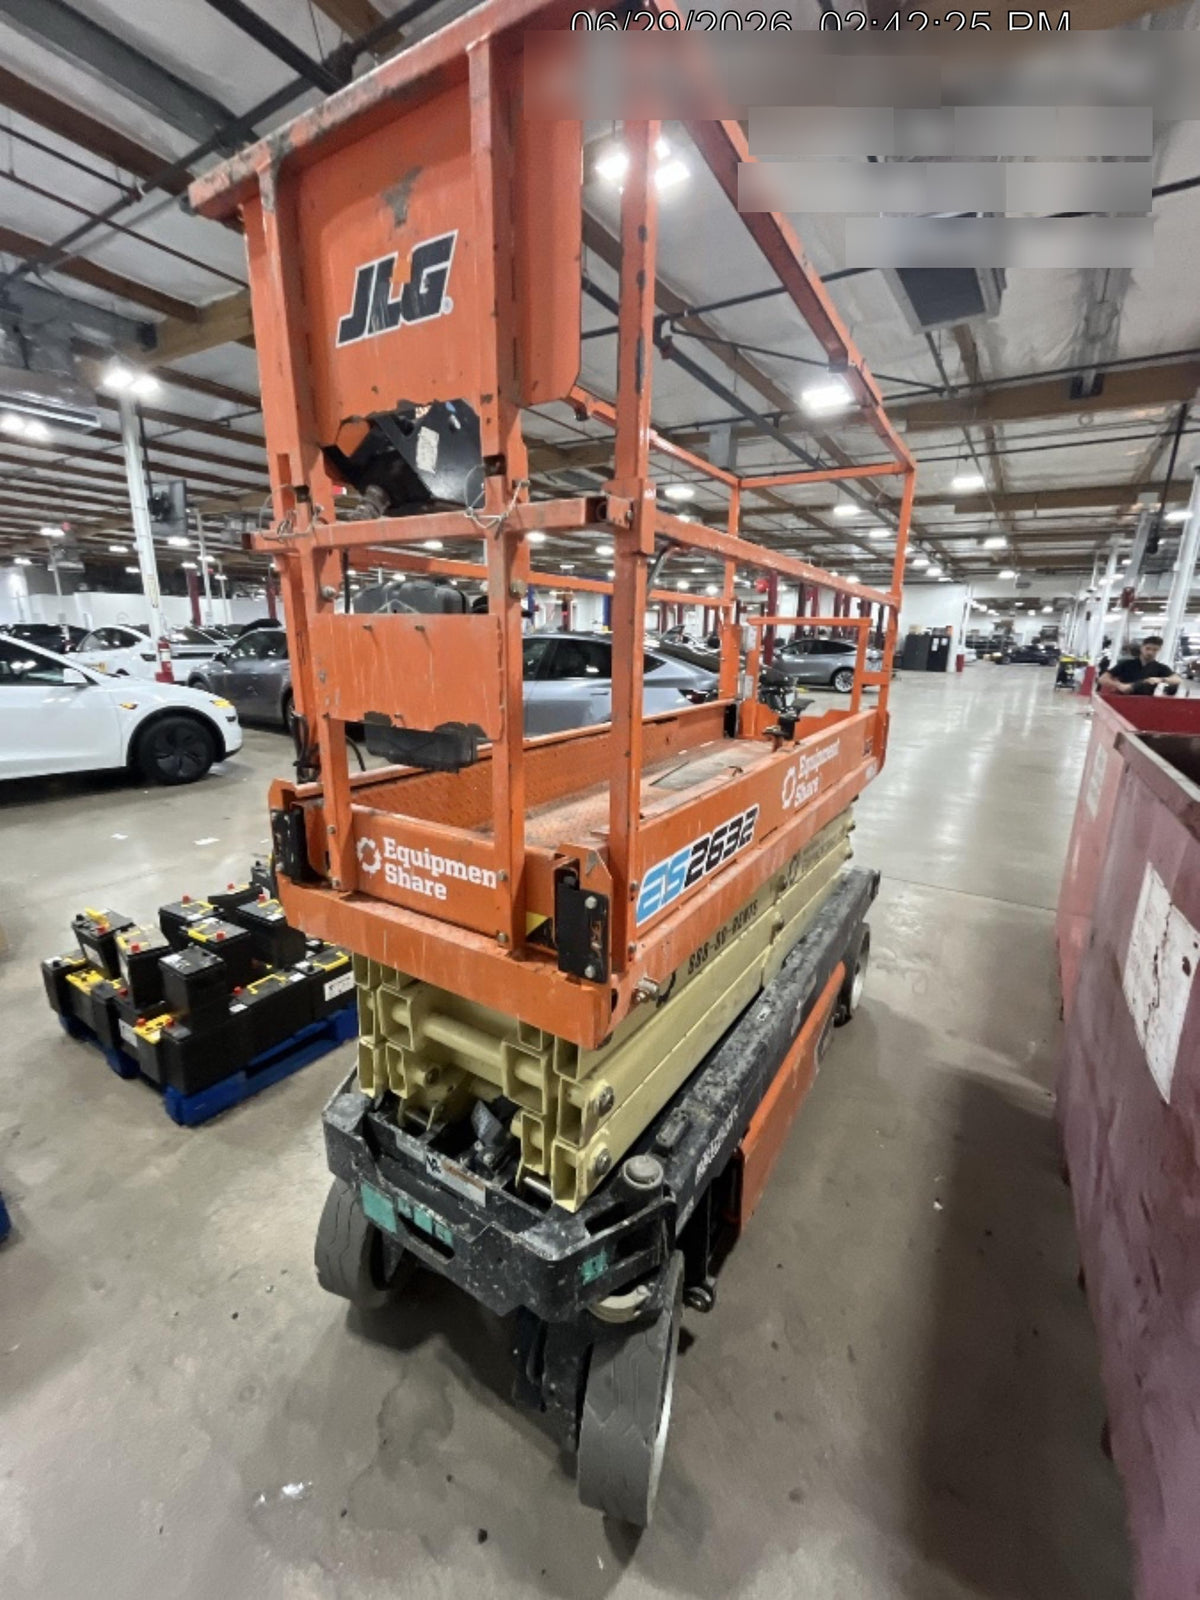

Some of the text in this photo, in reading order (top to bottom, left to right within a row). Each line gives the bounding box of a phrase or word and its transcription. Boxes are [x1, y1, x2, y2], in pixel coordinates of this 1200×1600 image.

[336, 229, 458, 348] JLG
[383, 836, 497, 889] Equipmen
[384, 862, 448, 900] Share
[636, 803, 760, 928] ES2632
